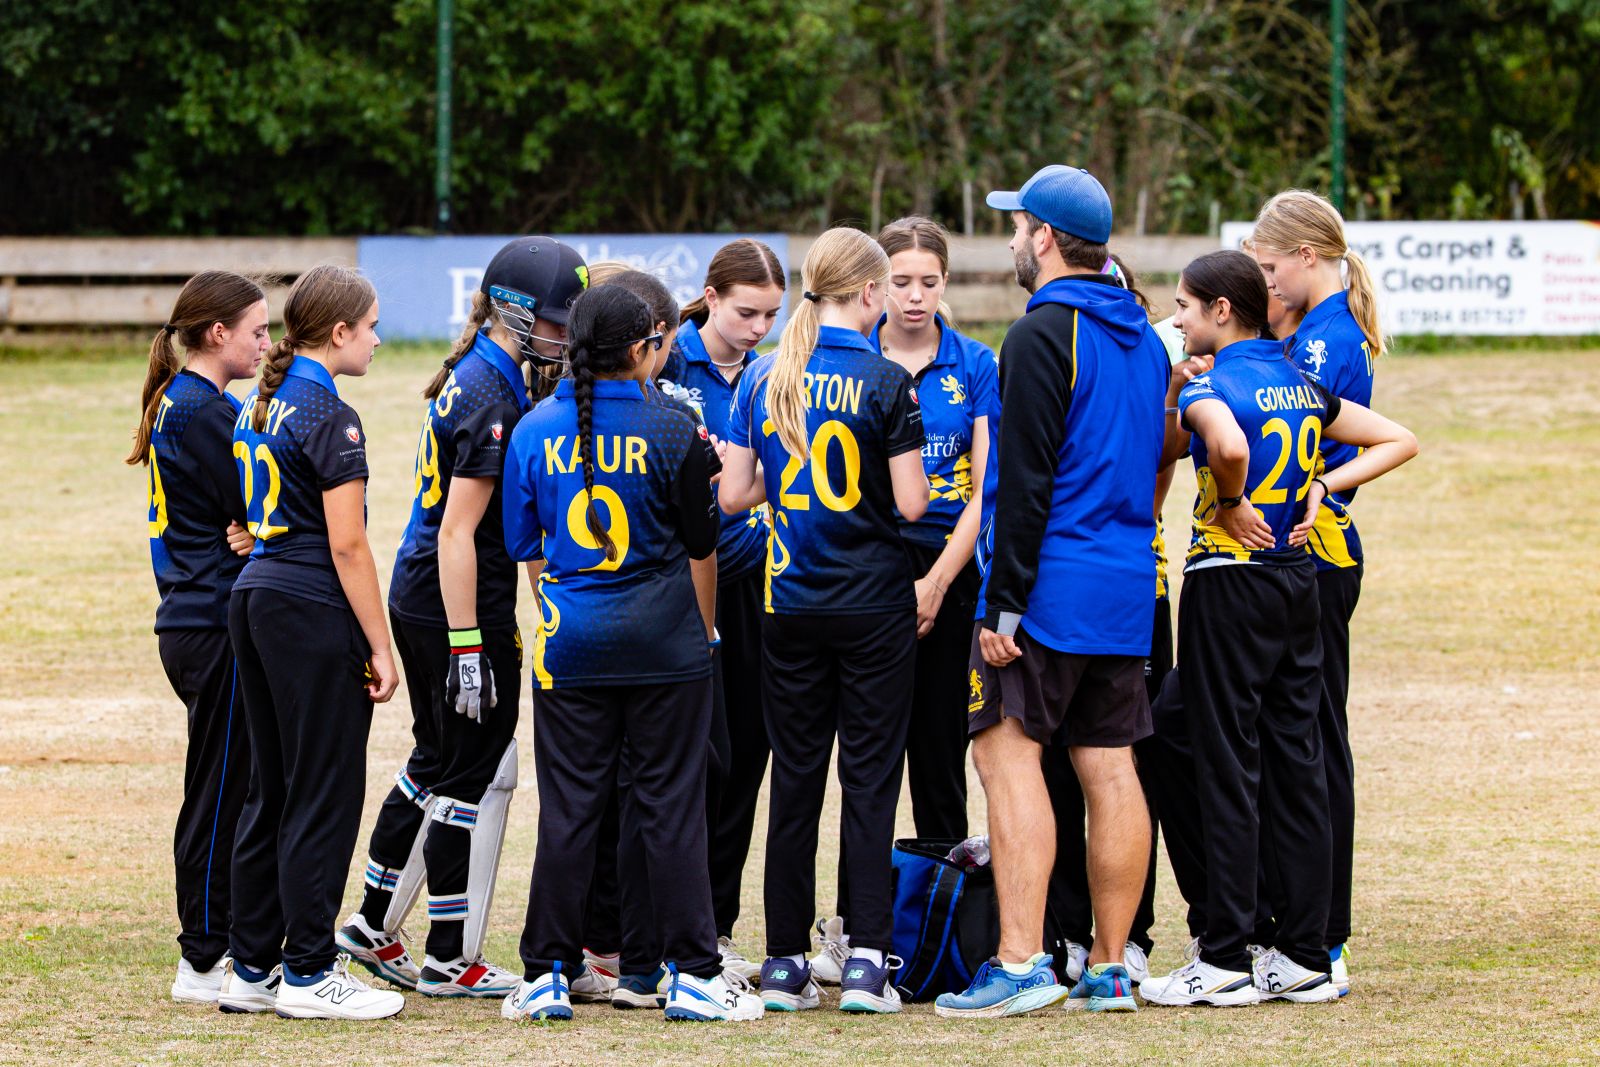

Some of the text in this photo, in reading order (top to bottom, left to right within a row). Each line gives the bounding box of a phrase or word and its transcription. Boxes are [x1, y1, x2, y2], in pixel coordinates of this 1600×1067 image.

[1397, 235, 1495, 263] Carpet
[1506, 234, 1527, 259] &
[504, 291, 521, 303] AIR
[1383, 268, 1512, 298] Cleaning
[543, 434, 648, 476] KAUR
[762, 420, 862, 512] 20
[1250, 415, 1322, 504] 29
[567, 484, 630, 572] 9
[1015, 975, 1046, 993] HOKA
